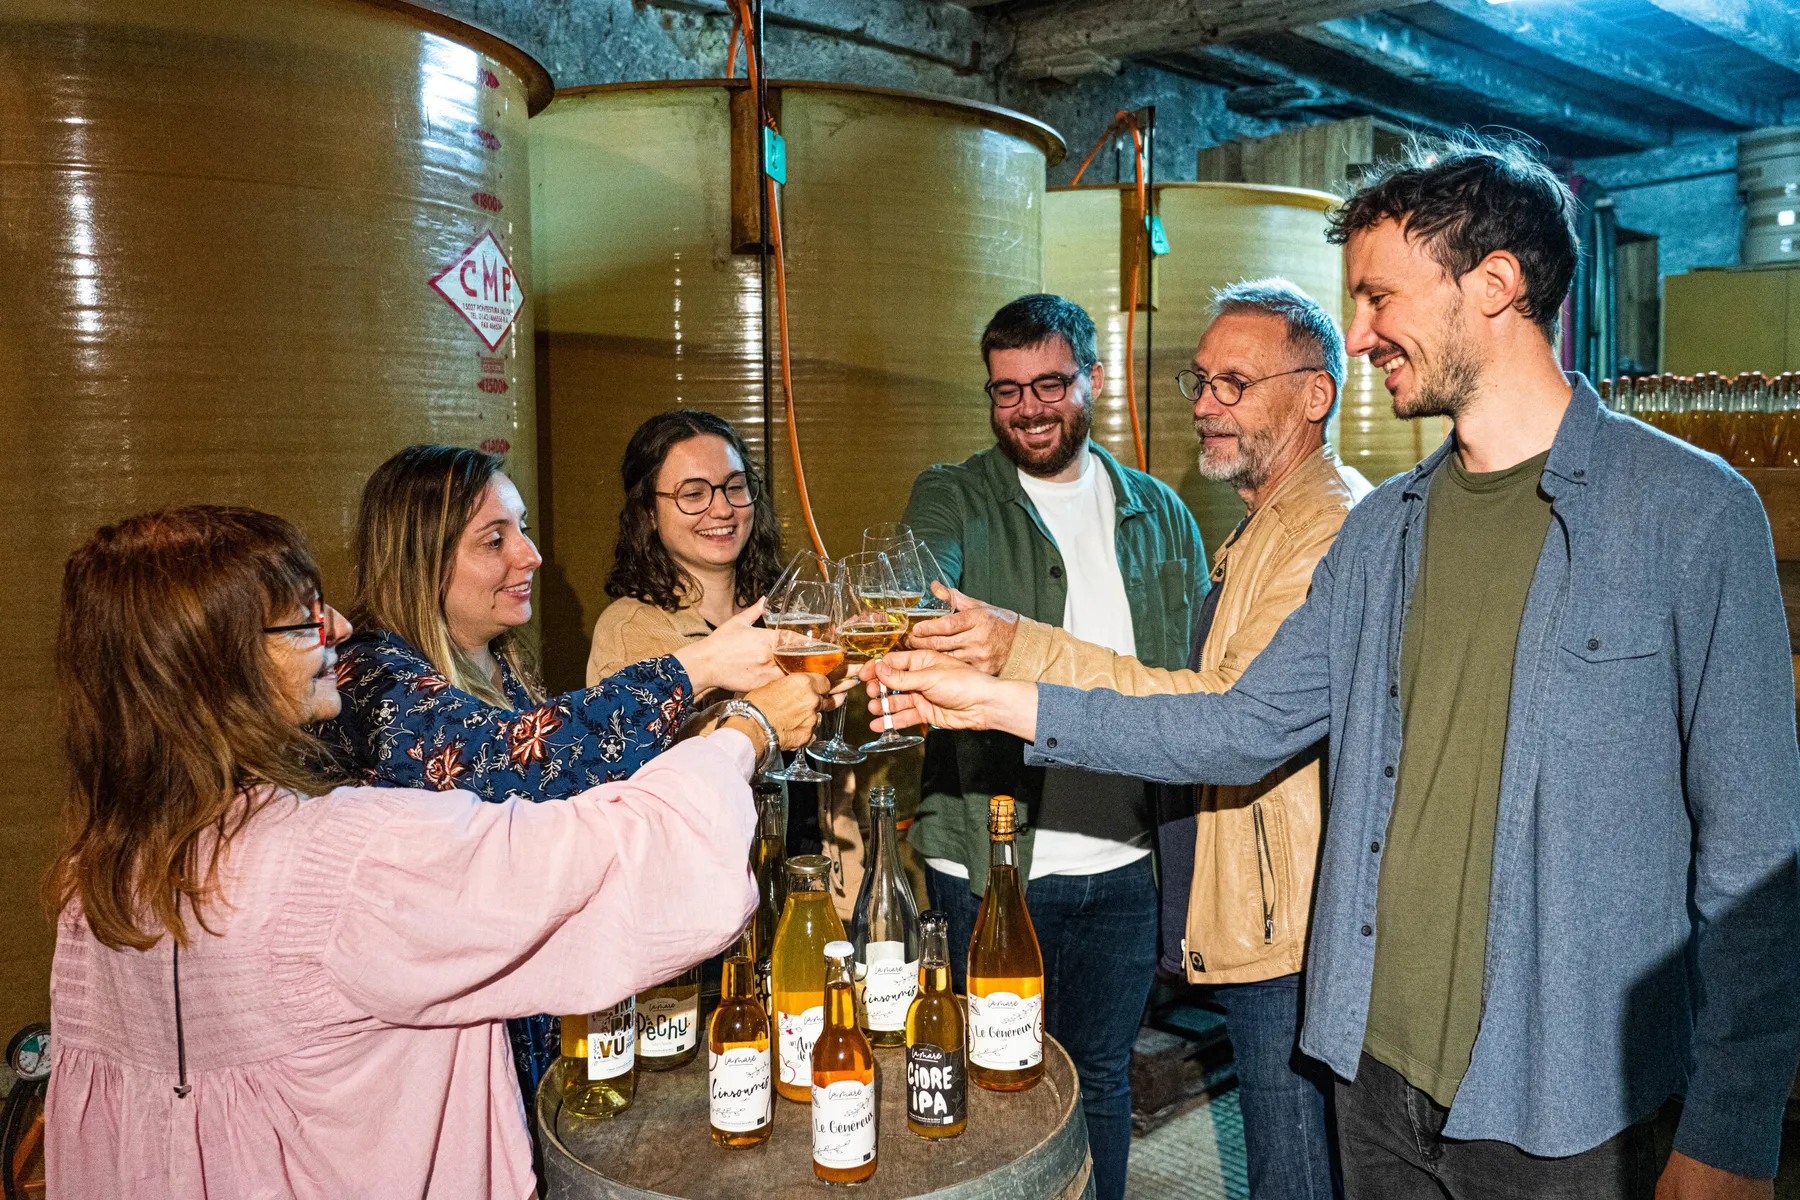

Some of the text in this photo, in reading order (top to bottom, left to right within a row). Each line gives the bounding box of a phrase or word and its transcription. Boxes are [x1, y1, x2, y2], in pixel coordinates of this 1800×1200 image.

[460, 254, 512, 302] CMP
[975, 1025, 986, 1037] Le
[815, 1118, 826, 1133] Le
